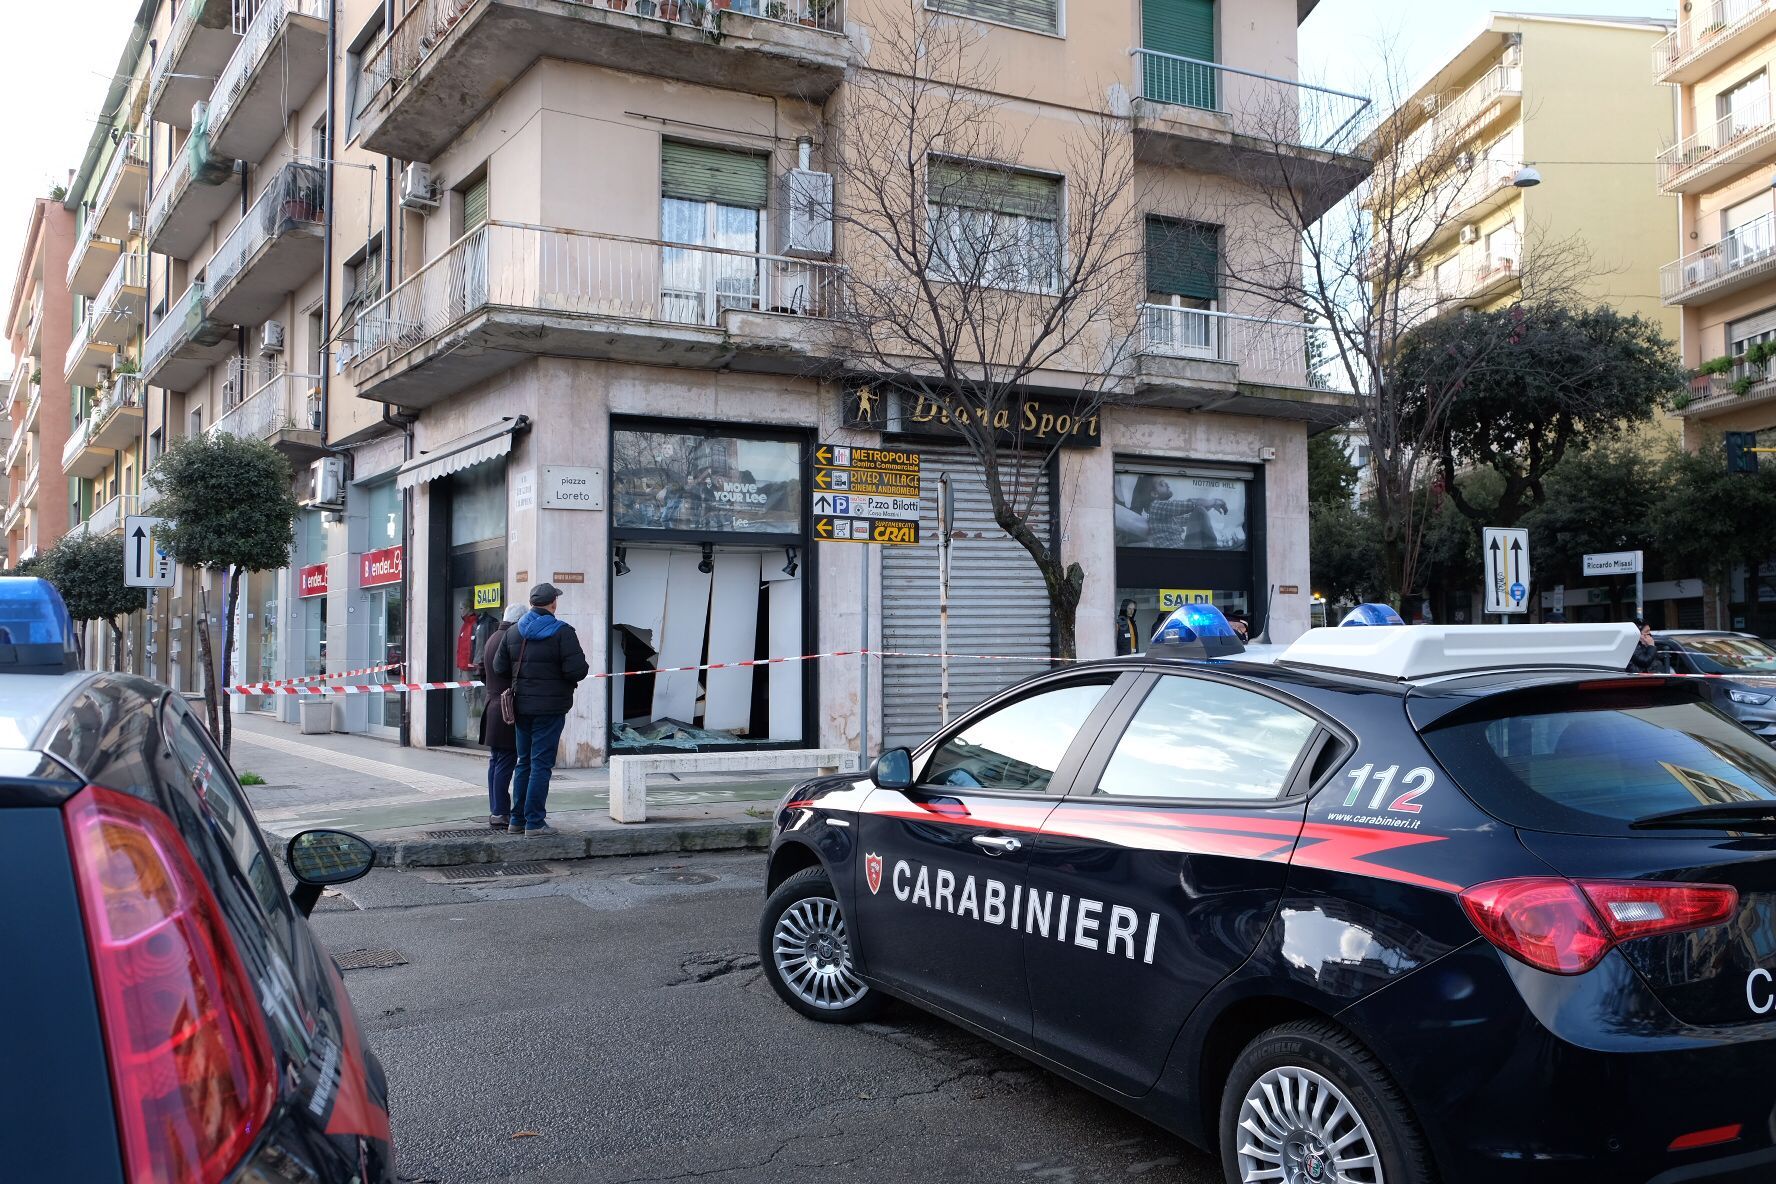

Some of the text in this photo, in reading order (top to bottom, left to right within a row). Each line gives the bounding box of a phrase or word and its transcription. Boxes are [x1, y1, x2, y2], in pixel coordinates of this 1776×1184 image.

[1021, 401, 1098, 438] Sport
[852, 449, 919, 464] METROPOLIS
[852, 460, 919, 472] Centro Commerciale
[561, 477, 586, 485] piazza
[850, 471, 919, 487] RIVER VILLAGE
[556, 491, 590, 501] Loreto
[713, 491, 744, 502] YOUR
[850, 483, 919, 495] CINEMA ANDROMEDA
[868, 497, 919, 512] P.zza Bilotti
[732, 516, 749, 529] Lee
[874, 521, 915, 529] SUPERMERCATO
[873, 527, 915, 542] CRAI
[1587, 560, 1613, 569] Riccardo
[1613, 559, 1633, 568] Misasi
[477, 587, 499, 604] SALDI
[1163, 593, 1210, 607] SALDI
[1342, 763, 1435, 814] 112
[1327, 812, 1421, 829] www.carabinieri.it
[892, 859, 1161, 964] CARABINIERI
[1746, 968, 1776, 1014] C
